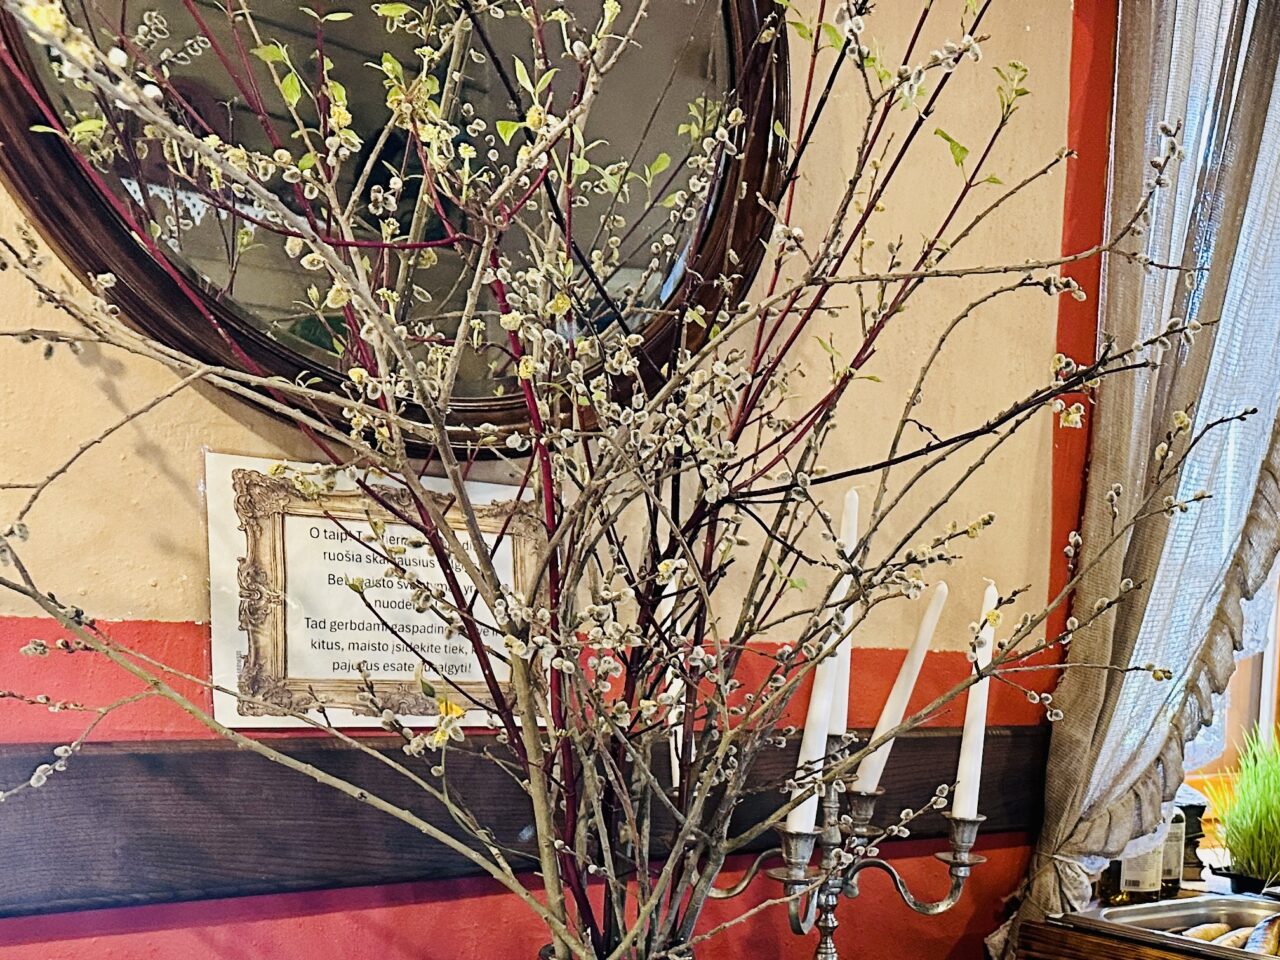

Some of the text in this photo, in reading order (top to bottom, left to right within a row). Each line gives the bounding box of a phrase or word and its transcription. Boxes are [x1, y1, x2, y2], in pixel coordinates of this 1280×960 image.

[309, 526, 320, 539] O
[304, 617, 326, 630] Tad
[310, 639, 345, 652] kitus,
[348, 640, 389, 652] maisto
[382, 662, 415, 672] esate
